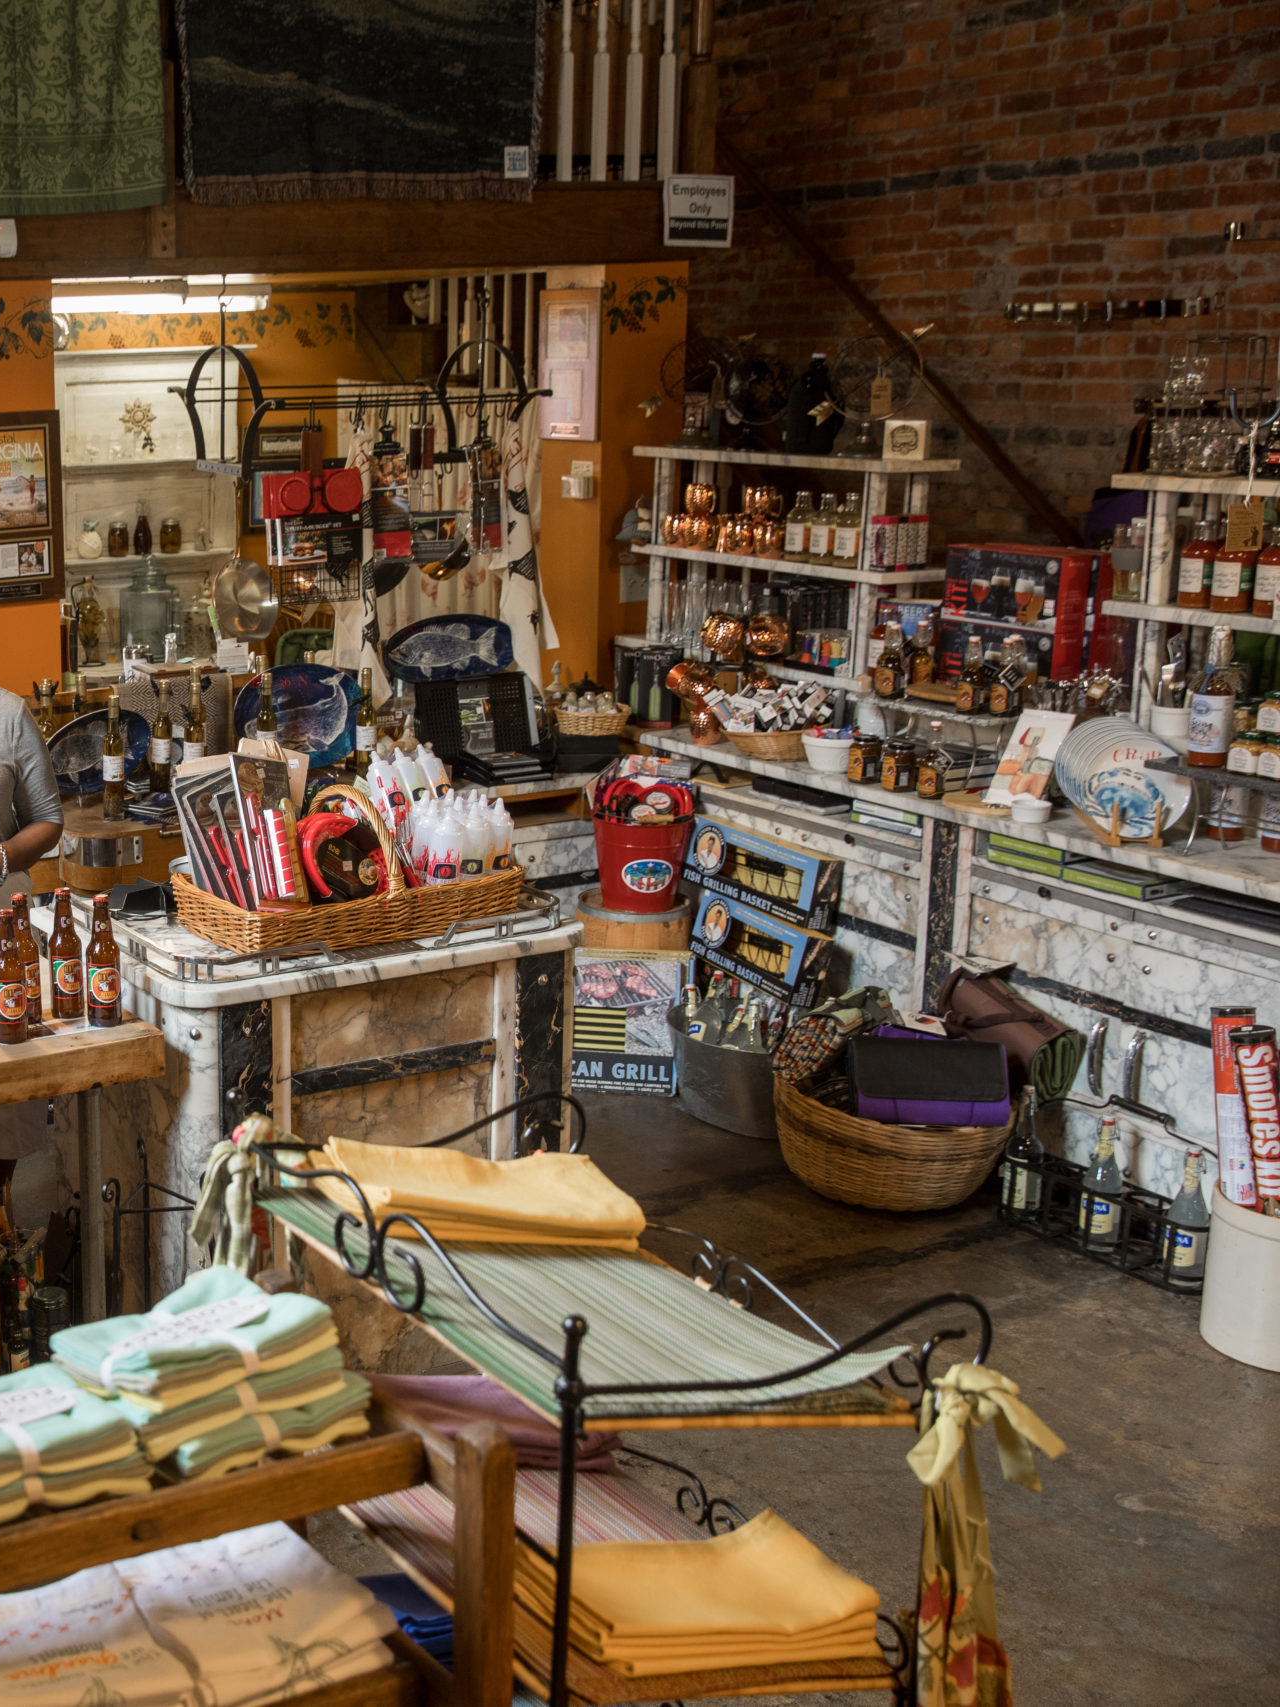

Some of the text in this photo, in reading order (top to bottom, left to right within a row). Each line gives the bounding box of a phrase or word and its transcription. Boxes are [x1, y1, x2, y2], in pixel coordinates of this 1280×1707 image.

[672, 184, 727, 198] Employees
[689, 202, 712, 217] Only
[670, 219, 728, 231] Beyond this Point
[683, 868, 701, 884] FISH
[703, 876, 739, 898] GRILLING
[740, 890, 773, 912] BASKET
[690, 941, 763, 986] FISH GRILLING BASKET
[612, 1062, 670, 1082] GRILL
